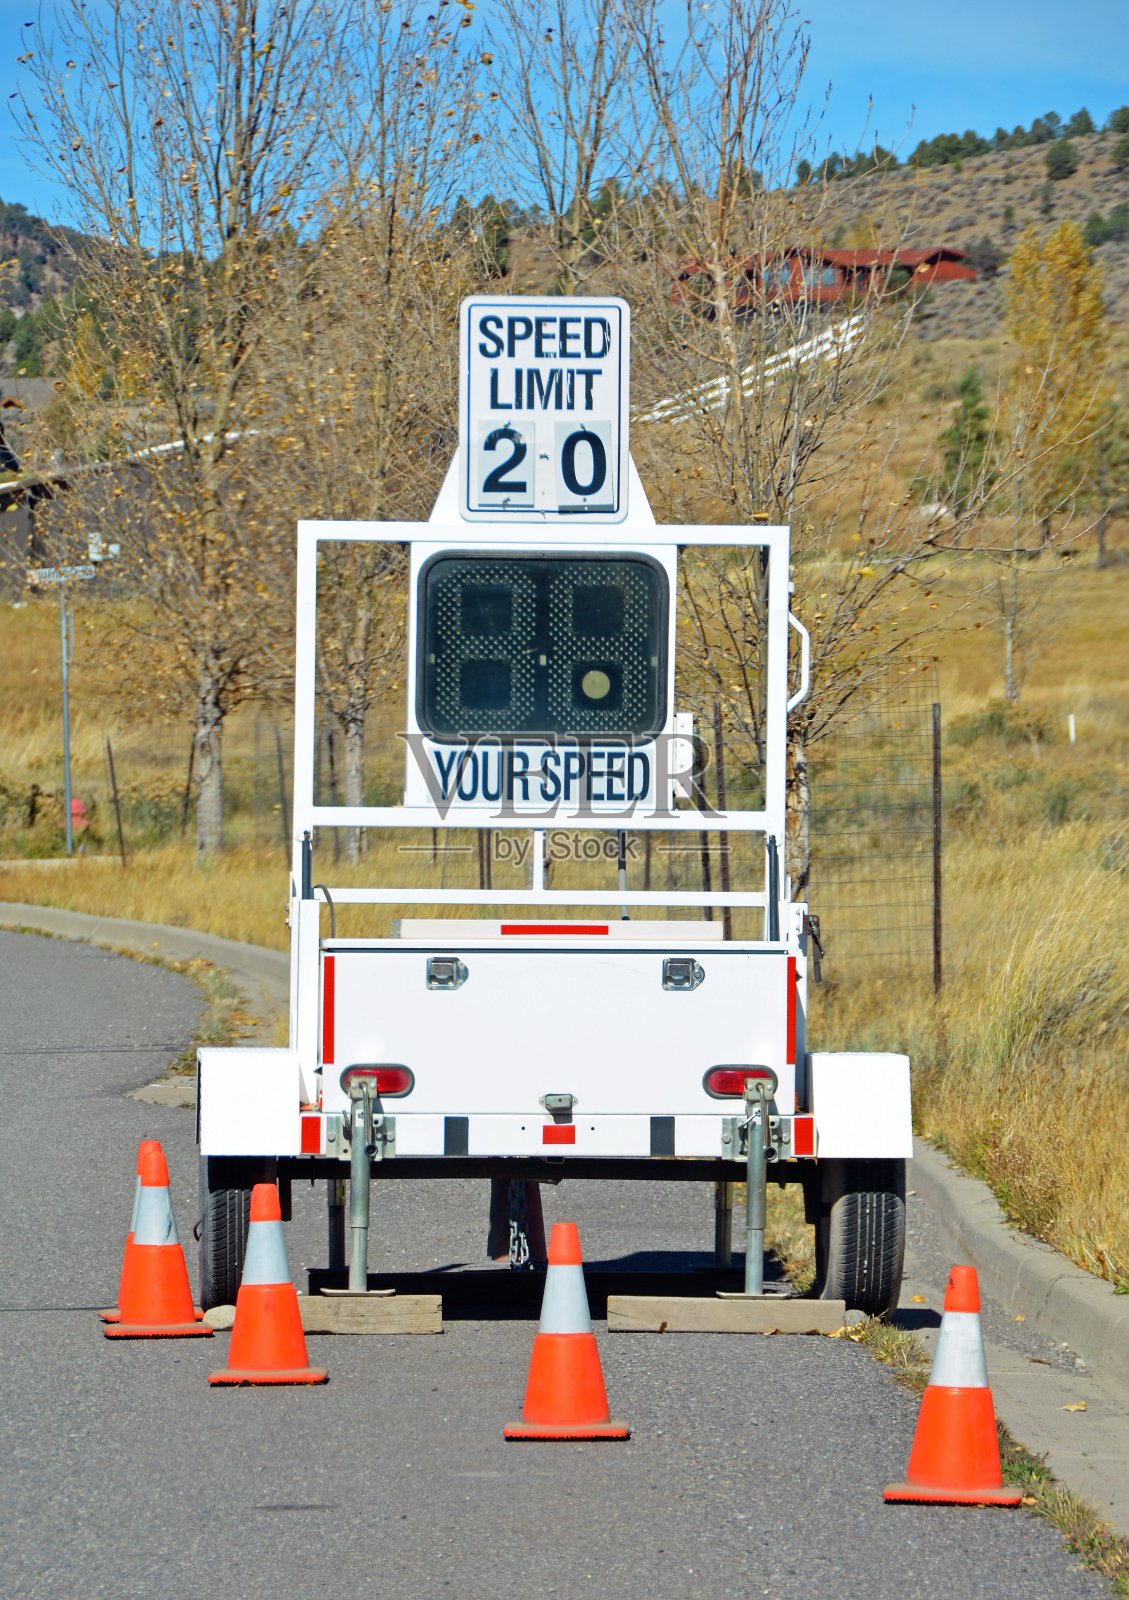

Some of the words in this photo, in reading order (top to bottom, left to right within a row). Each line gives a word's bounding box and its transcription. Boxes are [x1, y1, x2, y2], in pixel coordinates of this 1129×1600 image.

[478, 314, 612, 359] SPEED
[490, 367, 603, 410] LIMIT
[434, 750, 530, 801] YOUR
[540, 750, 650, 801] SPEED
